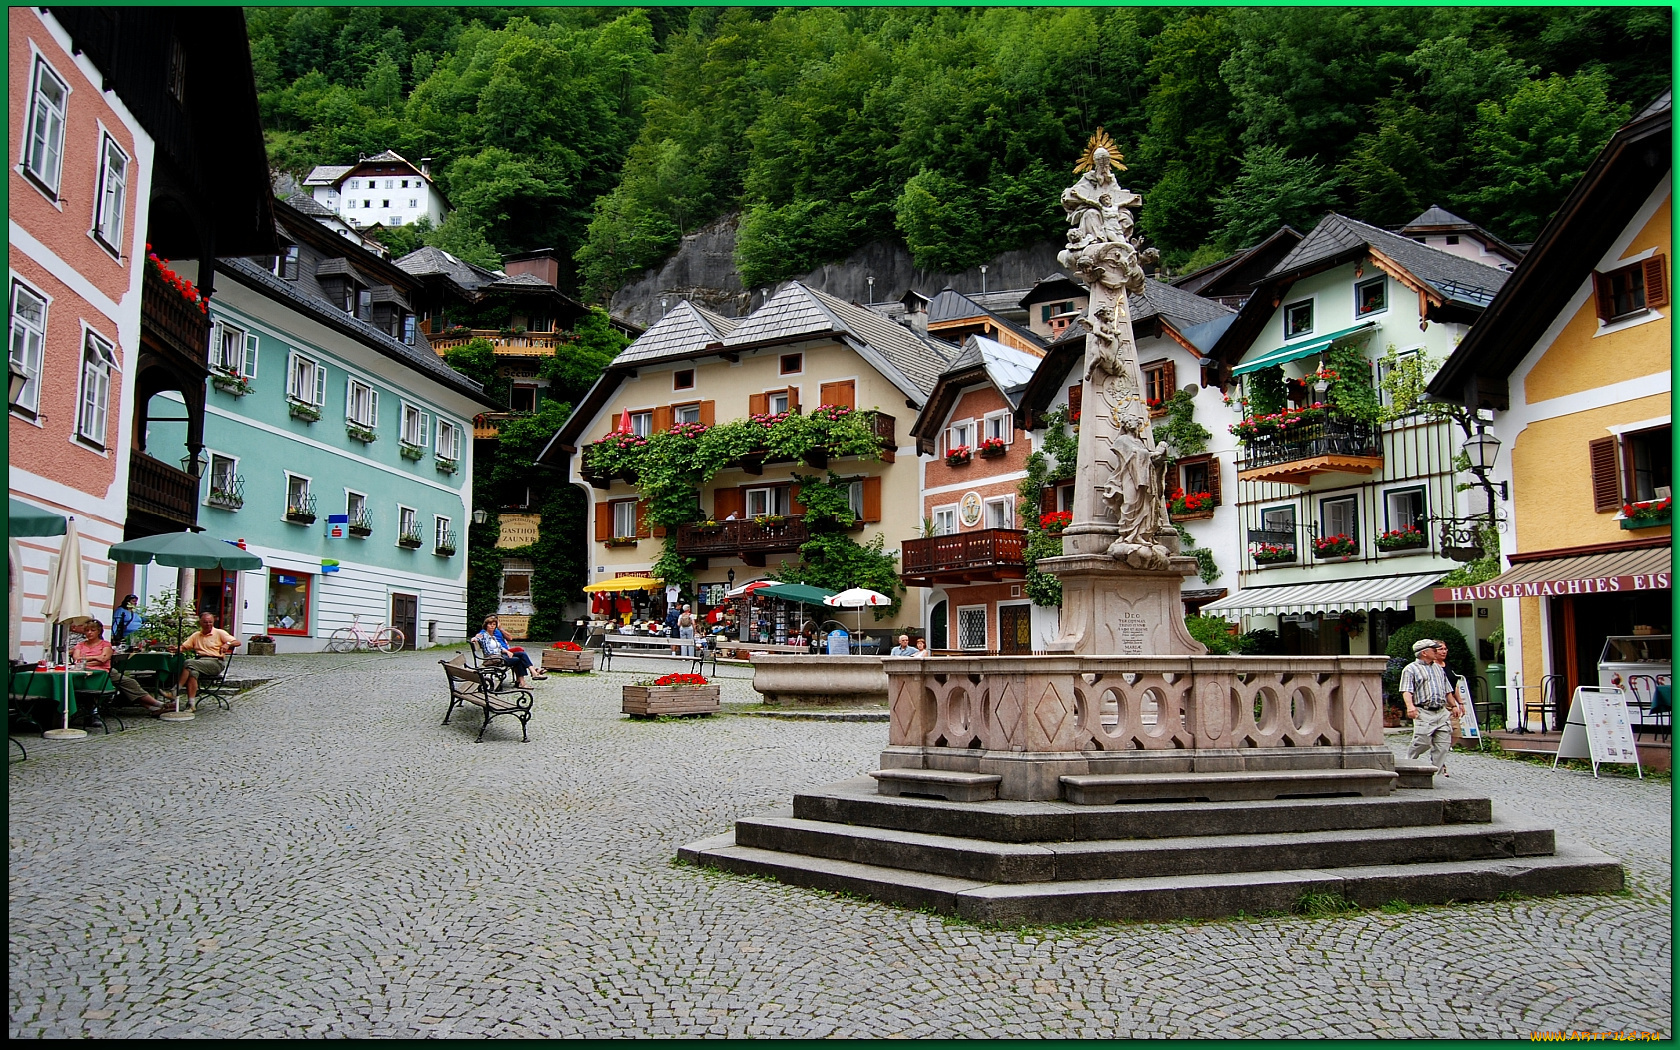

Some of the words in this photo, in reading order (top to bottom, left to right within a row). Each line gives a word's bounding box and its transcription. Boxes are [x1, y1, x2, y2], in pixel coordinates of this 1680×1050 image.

[501, 527, 537, 535] GASTHOF
[1451, 576, 1620, 601] HAUSGEMACHTES
[1633, 573, 1668, 590] EIS
